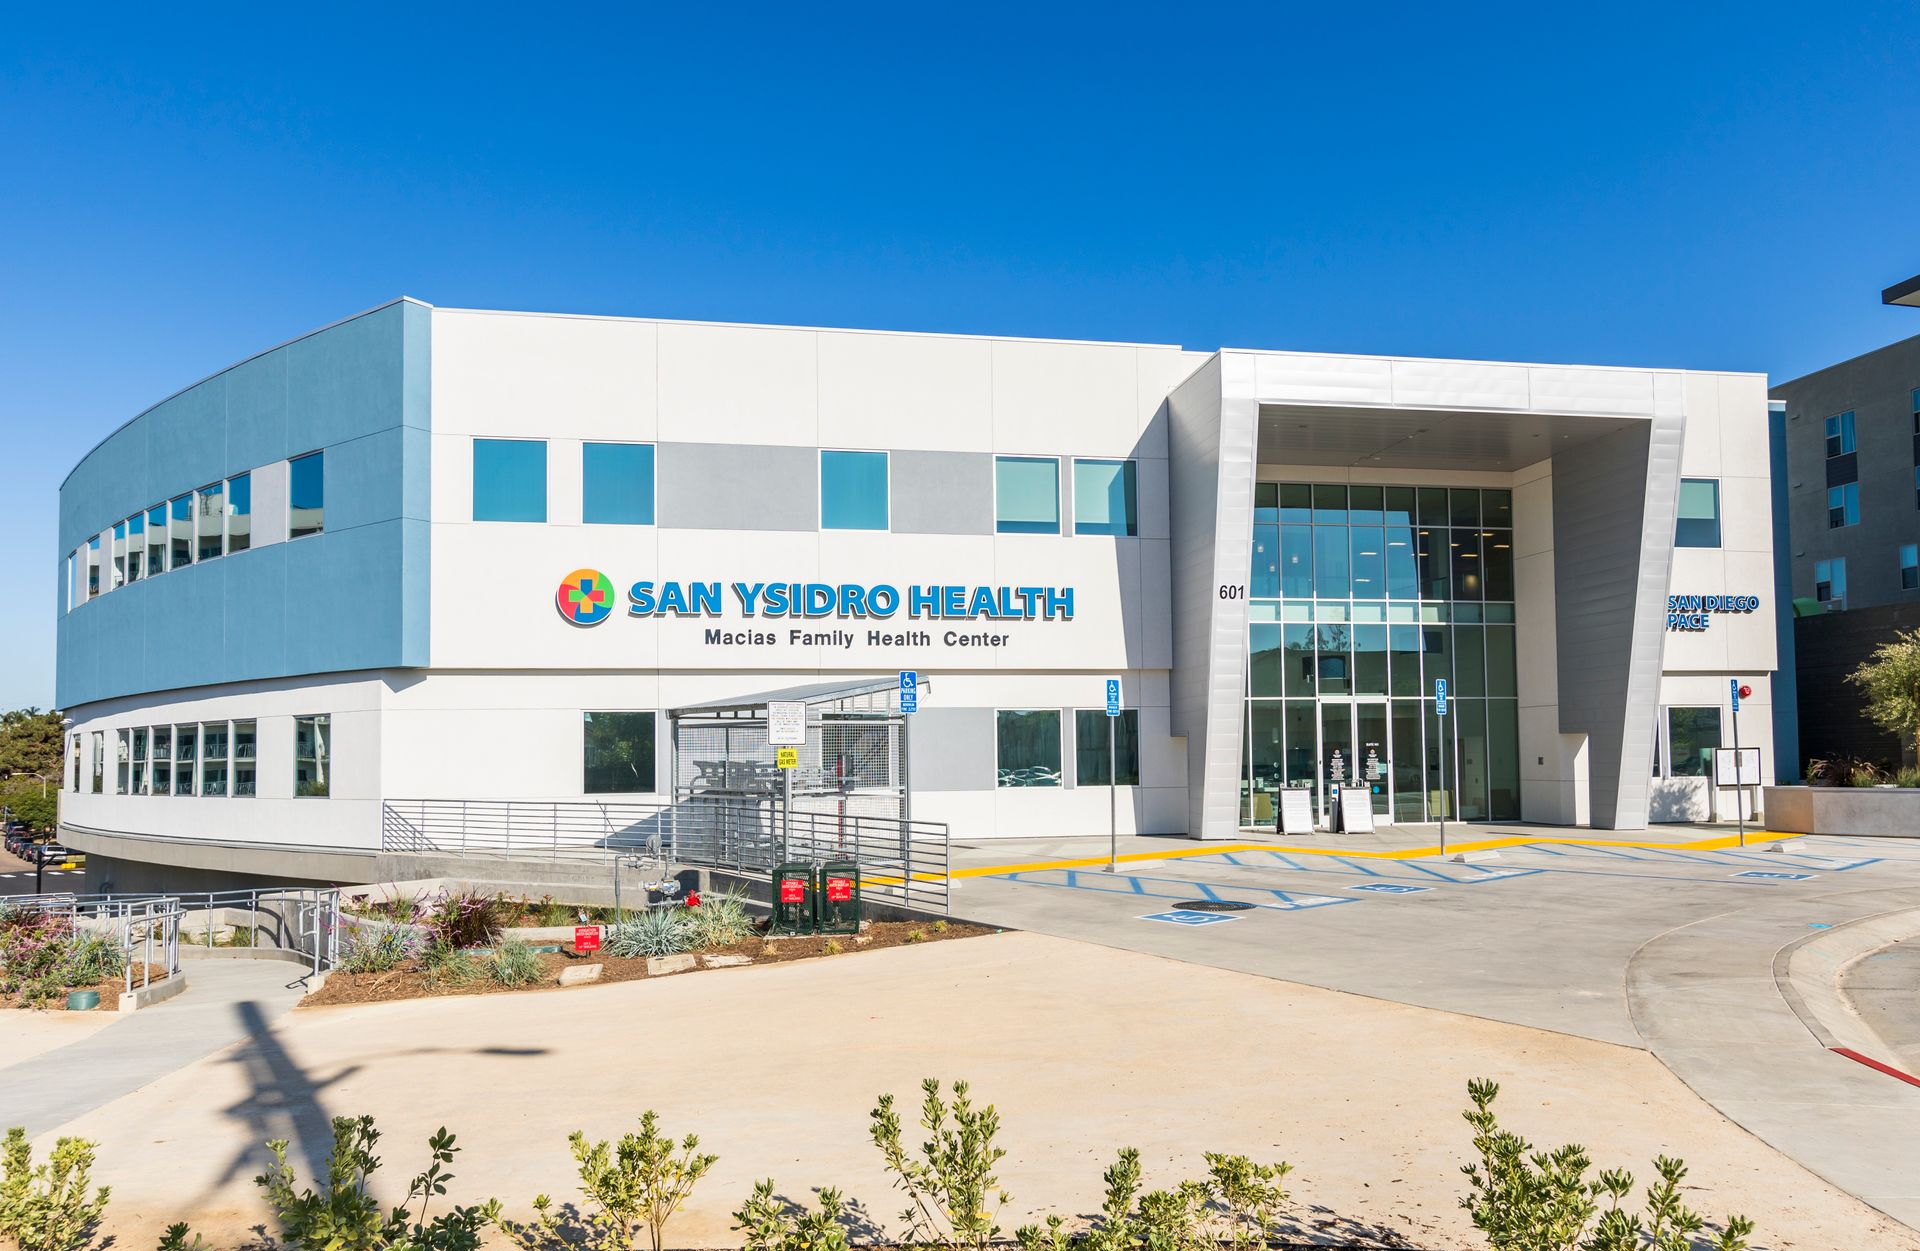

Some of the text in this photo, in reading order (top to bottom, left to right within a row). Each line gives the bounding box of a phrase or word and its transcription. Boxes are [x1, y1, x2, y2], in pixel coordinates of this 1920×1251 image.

[629, 581, 1075, 618] SAN YSIDRO HEALTH
[1219, 584, 1244, 600] 601
[1667, 595, 1760, 610] SAN DIEGO
[1667, 614, 1710, 628] PACE
[705, 628, 1010, 650] Macias Family Health Center
